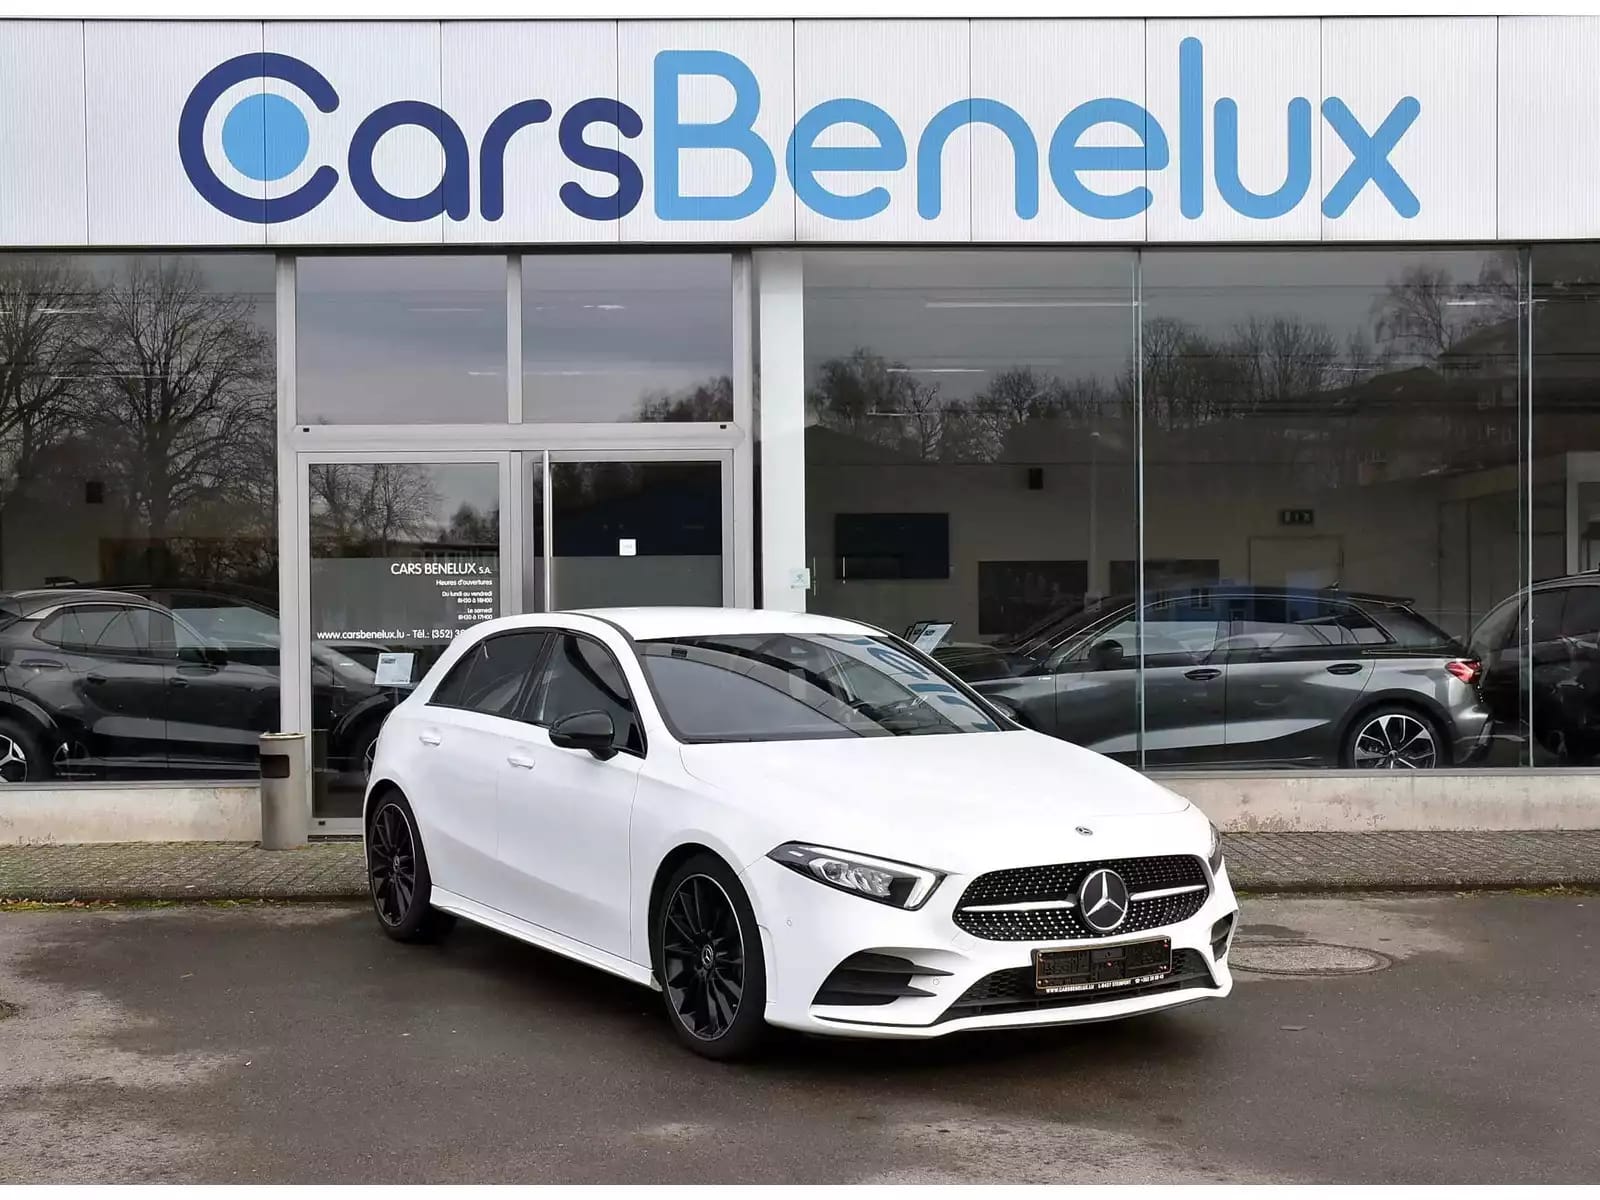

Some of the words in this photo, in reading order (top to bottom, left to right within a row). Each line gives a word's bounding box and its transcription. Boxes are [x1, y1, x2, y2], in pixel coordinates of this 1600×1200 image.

[178, 37, 1421, 224] CarsBenelux
[390, 563, 422, 575] CARS
[424, 563, 476, 575] BENELUX
[457, 578, 492, 586] d'ouvertures
[317, 630, 405, 639] www.carsbenelux.lu
[432, 629, 453, 639] (352)
